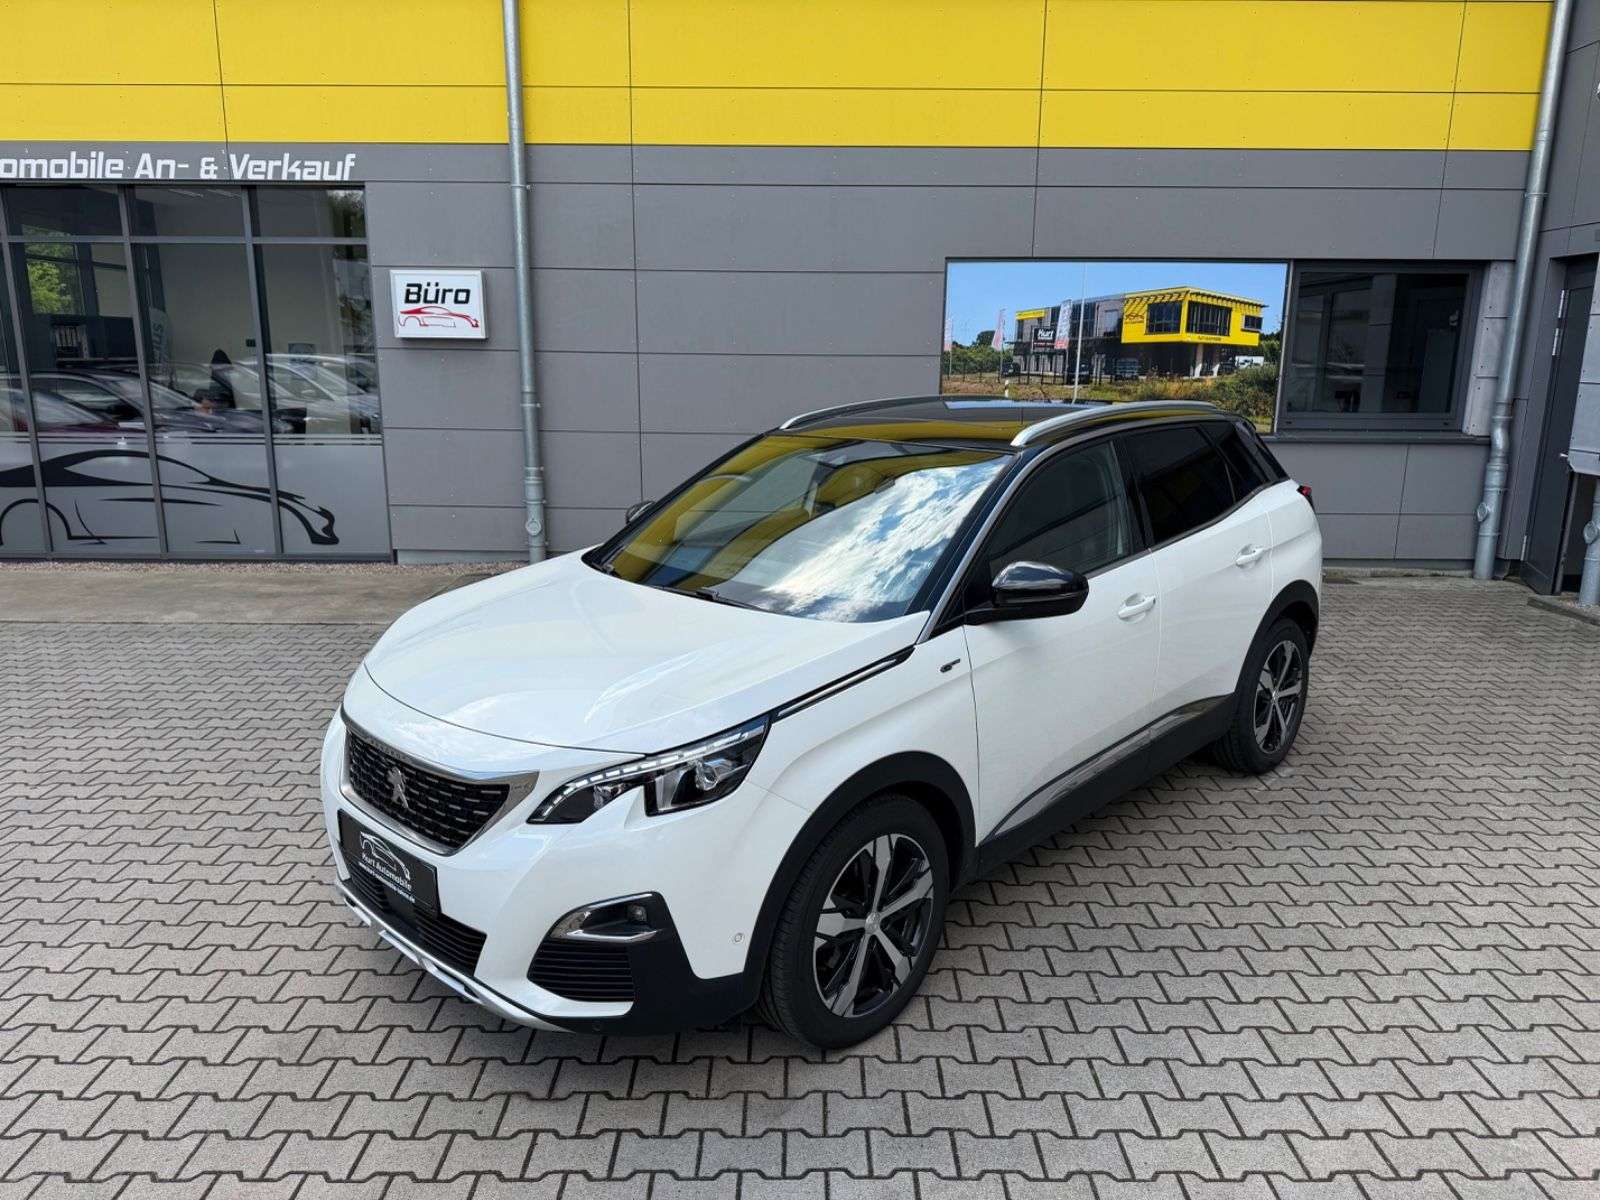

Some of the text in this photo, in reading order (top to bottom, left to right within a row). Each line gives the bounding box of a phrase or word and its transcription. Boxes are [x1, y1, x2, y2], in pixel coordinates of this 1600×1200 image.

[0, 151, 356, 181] omobile An- & Verkauf
[404, 282, 471, 304] Büro
